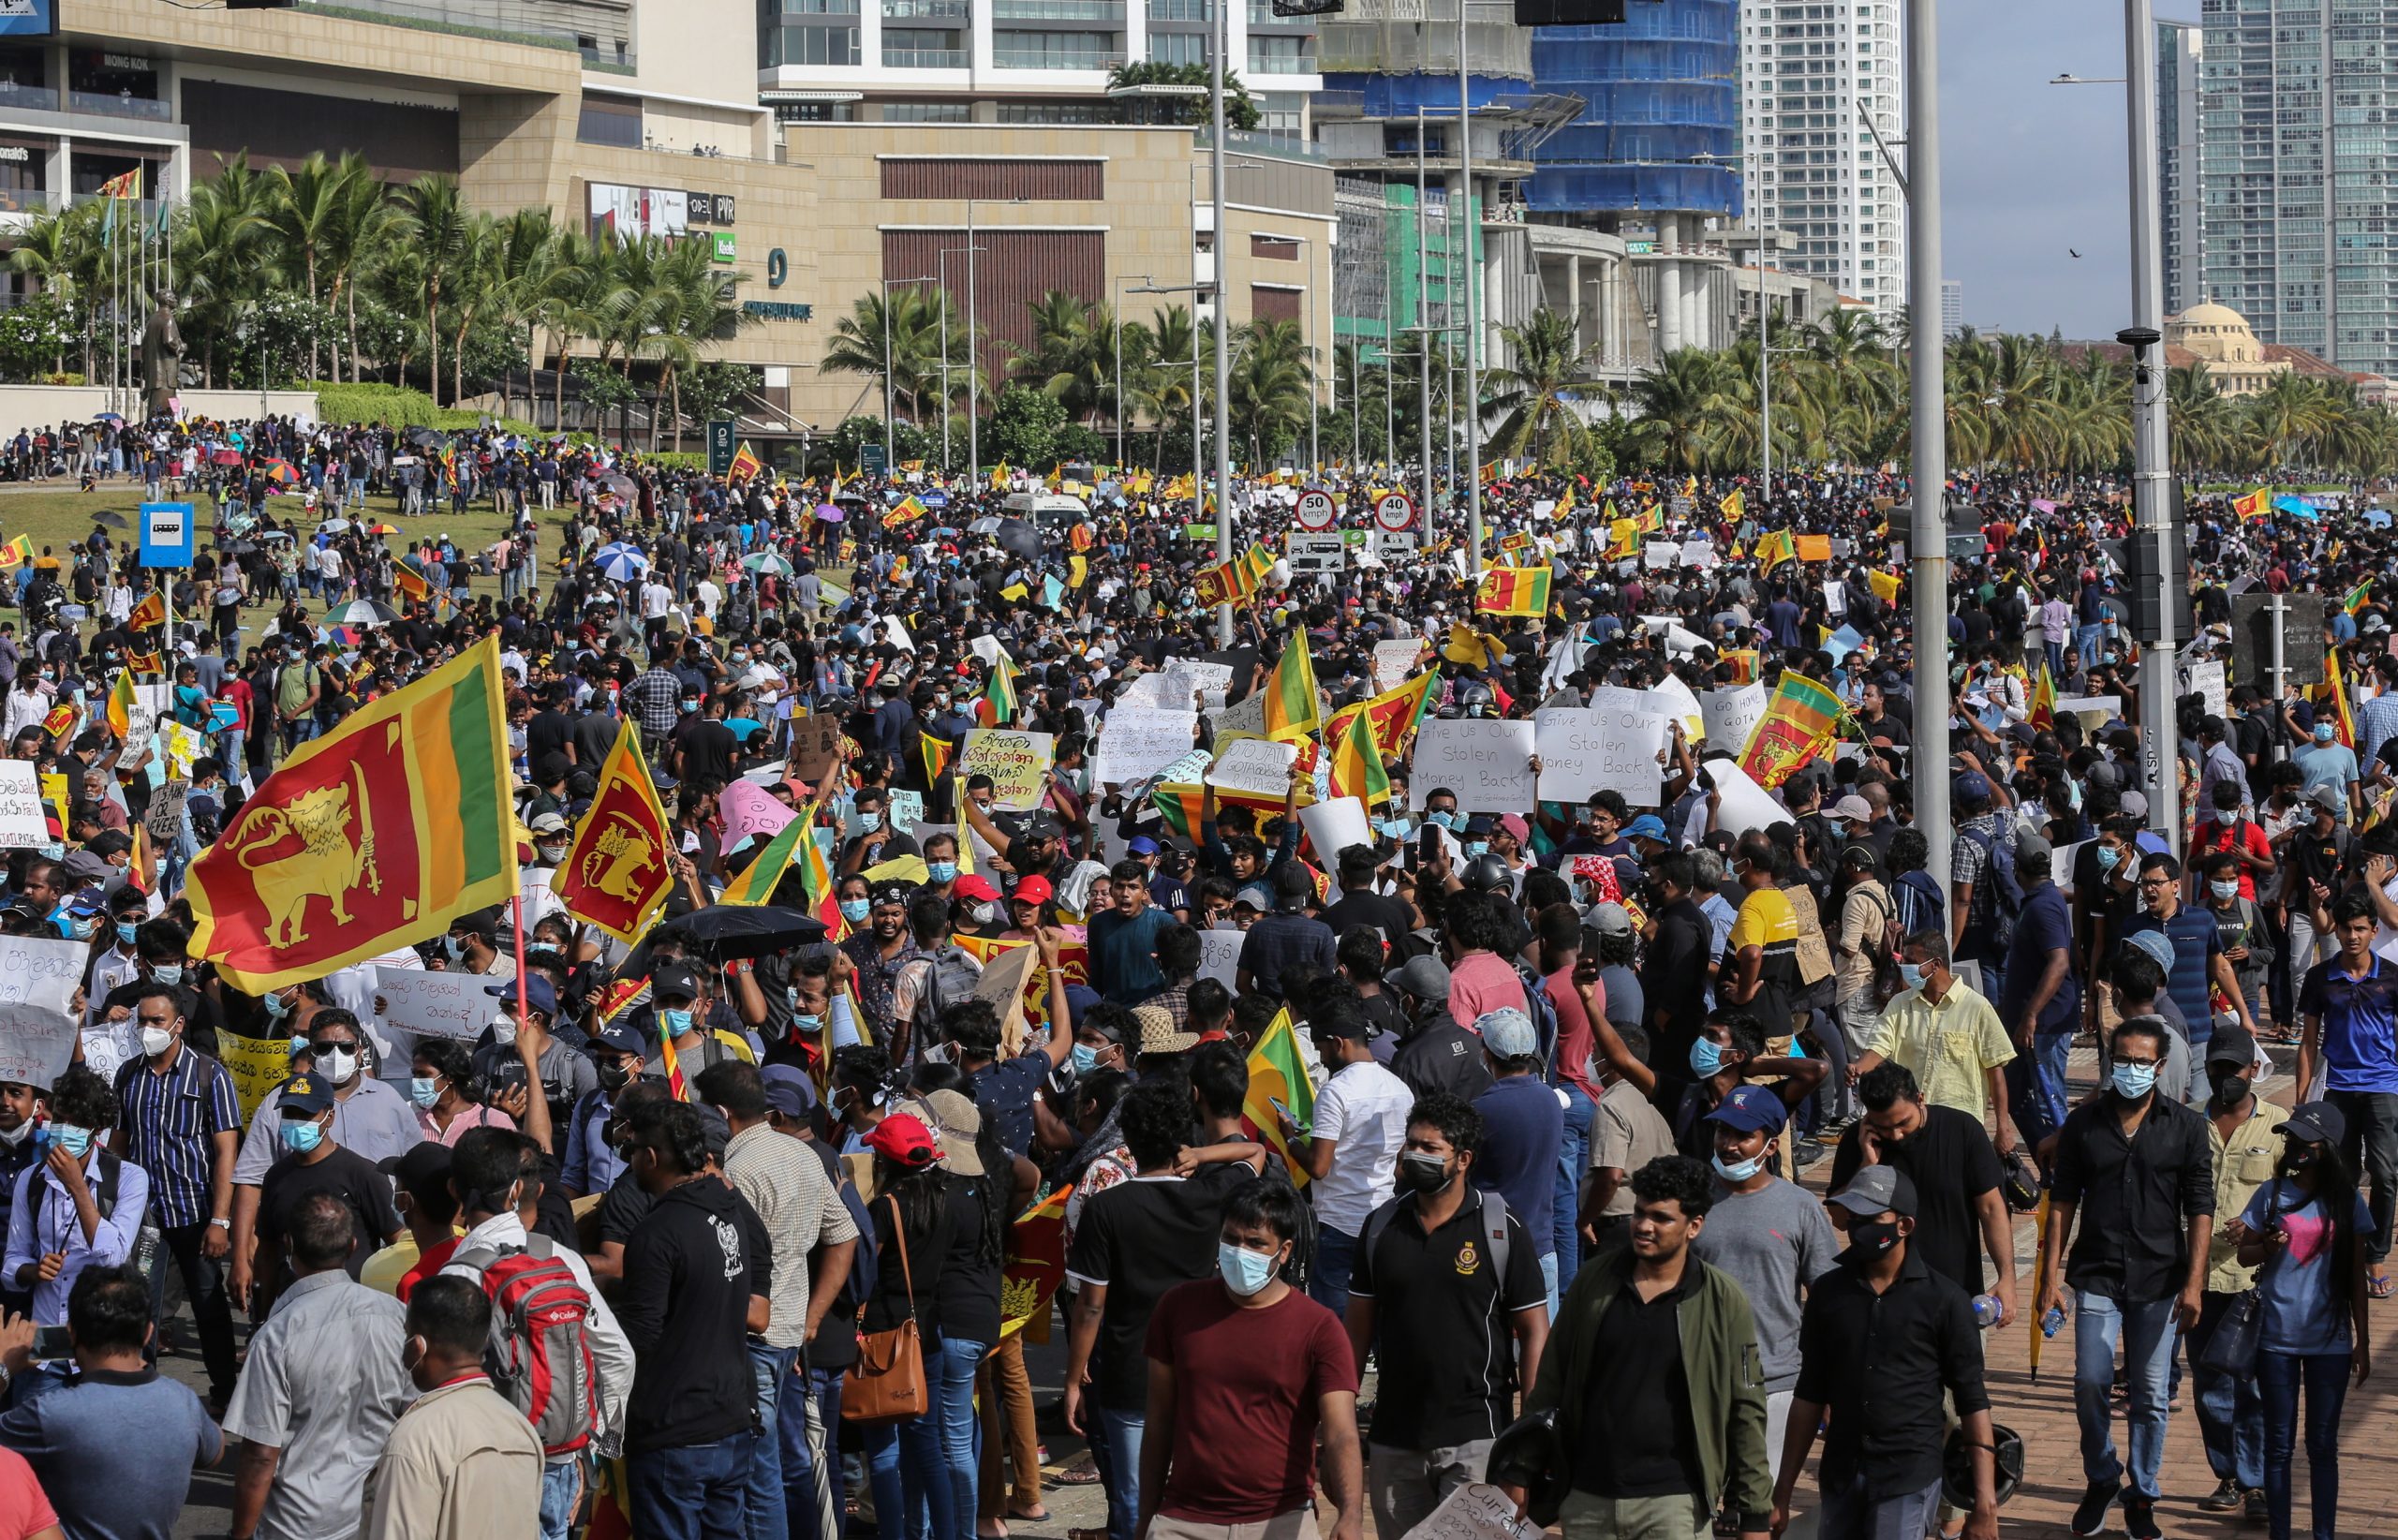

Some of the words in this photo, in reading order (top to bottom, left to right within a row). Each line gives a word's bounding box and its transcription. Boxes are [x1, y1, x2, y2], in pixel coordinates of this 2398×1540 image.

[104, 54, 129, 68] MONG
[130, 58, 149, 71] KOK
[718, 195, 734, 223] PVR
[718, 240, 735, 256] Keells
[1306, 497, 1324, 508] 50
[1386, 498, 1403, 510] 40
[1303, 509, 1328, 519] kmph
[1385, 511, 1403, 521] kmph
[1715, 701, 1733, 712] GO
[1739, 691, 1761, 709] HOME
[1541, 711, 1576, 728] Give
[1590, 713, 1608, 727] Us
[1620, 713, 1657, 730] Our
[1724, 713, 1754, 727] GOTA
[1419, 721, 1451, 739] Give
[1459, 721, 1477, 738] Us
[1488, 722, 1519, 738] Our
[1568, 732, 1626, 752] Stolen
[1237, 742, 1252, 758] TO
[1255, 743, 1289, 765] JAIL
[1442, 744, 1499, 763] Stolen
[1603, 755, 1650, 780] Back!
[19, 777, 37, 795] Sale
[1417, 771, 1465, 792] Money
[22, 802, 39, 816] Fail
[155, 802, 169, 818] OR
[519, 883, 556, 904] OTA
